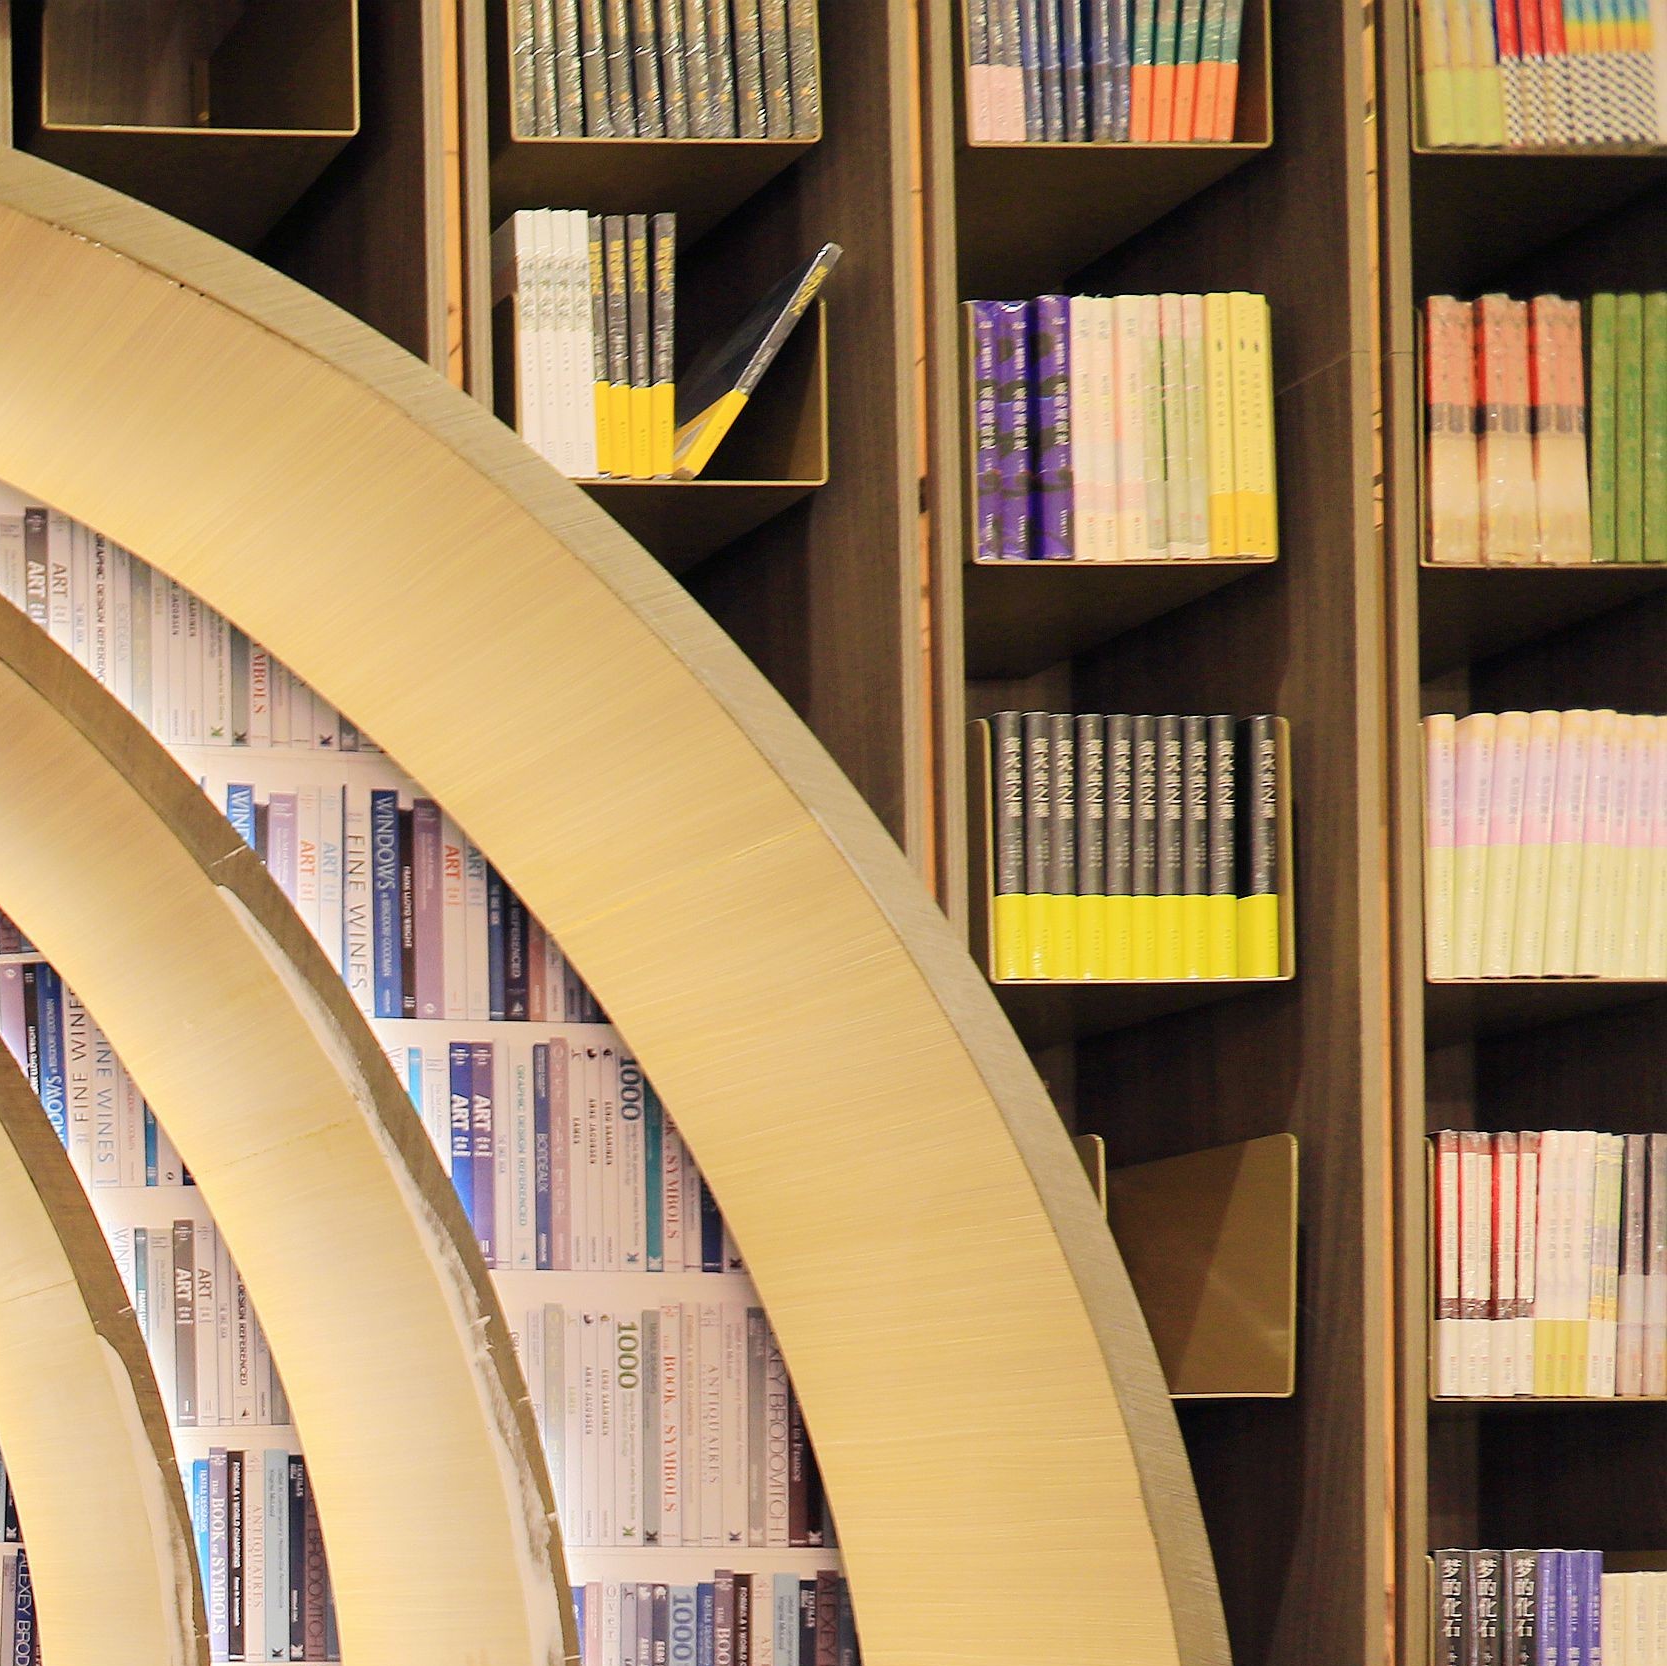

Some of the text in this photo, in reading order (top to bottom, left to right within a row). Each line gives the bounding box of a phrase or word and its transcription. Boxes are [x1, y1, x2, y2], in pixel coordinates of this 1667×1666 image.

[299, 839, 317, 878] ART
[322, 841, 339, 878] ART
[375, 794, 397, 891] WINDOWS
[444, 844, 461, 881] ART
[347, 834, 368, 990] FINE WINES
[74, 1072, 90, 1123] FINE
[451, 1093, 470, 1132] ART
[473, 1093, 492, 1132] ART
[517, 1064, 525, 1110] GRAPHIC
[619, 1055, 641, 1121] 1000
[96, 1087, 115, 1164] WINES
[666, 1157, 681, 1240] SYMBOLS
[176, 1267, 194, 1302] ART
[237, 1286, 249, 1386] DESIGN REFERENCED
[617, 1321, 639, 1390] 1000
[663, 1355, 678, 1514] BOOK SYMBOLS
[708, 1365, 720, 1485] ANTIQUAIRES
[211, 1498, 227, 1635] BOOK SYMBOLS
[252, 1505, 264, 1609] ANTIQUAIRES
[672, 1593, 696, 1662] 1000
[818, 1577, 838, 1663] ALEXEY
[1441, 1558, 1463, 1638] 梦的化石
[1476, 1558, 1498, 1638] 梦的化石
[1514, 1558, 1535, 1638] 梦的化石
[638, 1637, 650, 1662] ARNE
[655, 1639, 666, 1662] EERO
